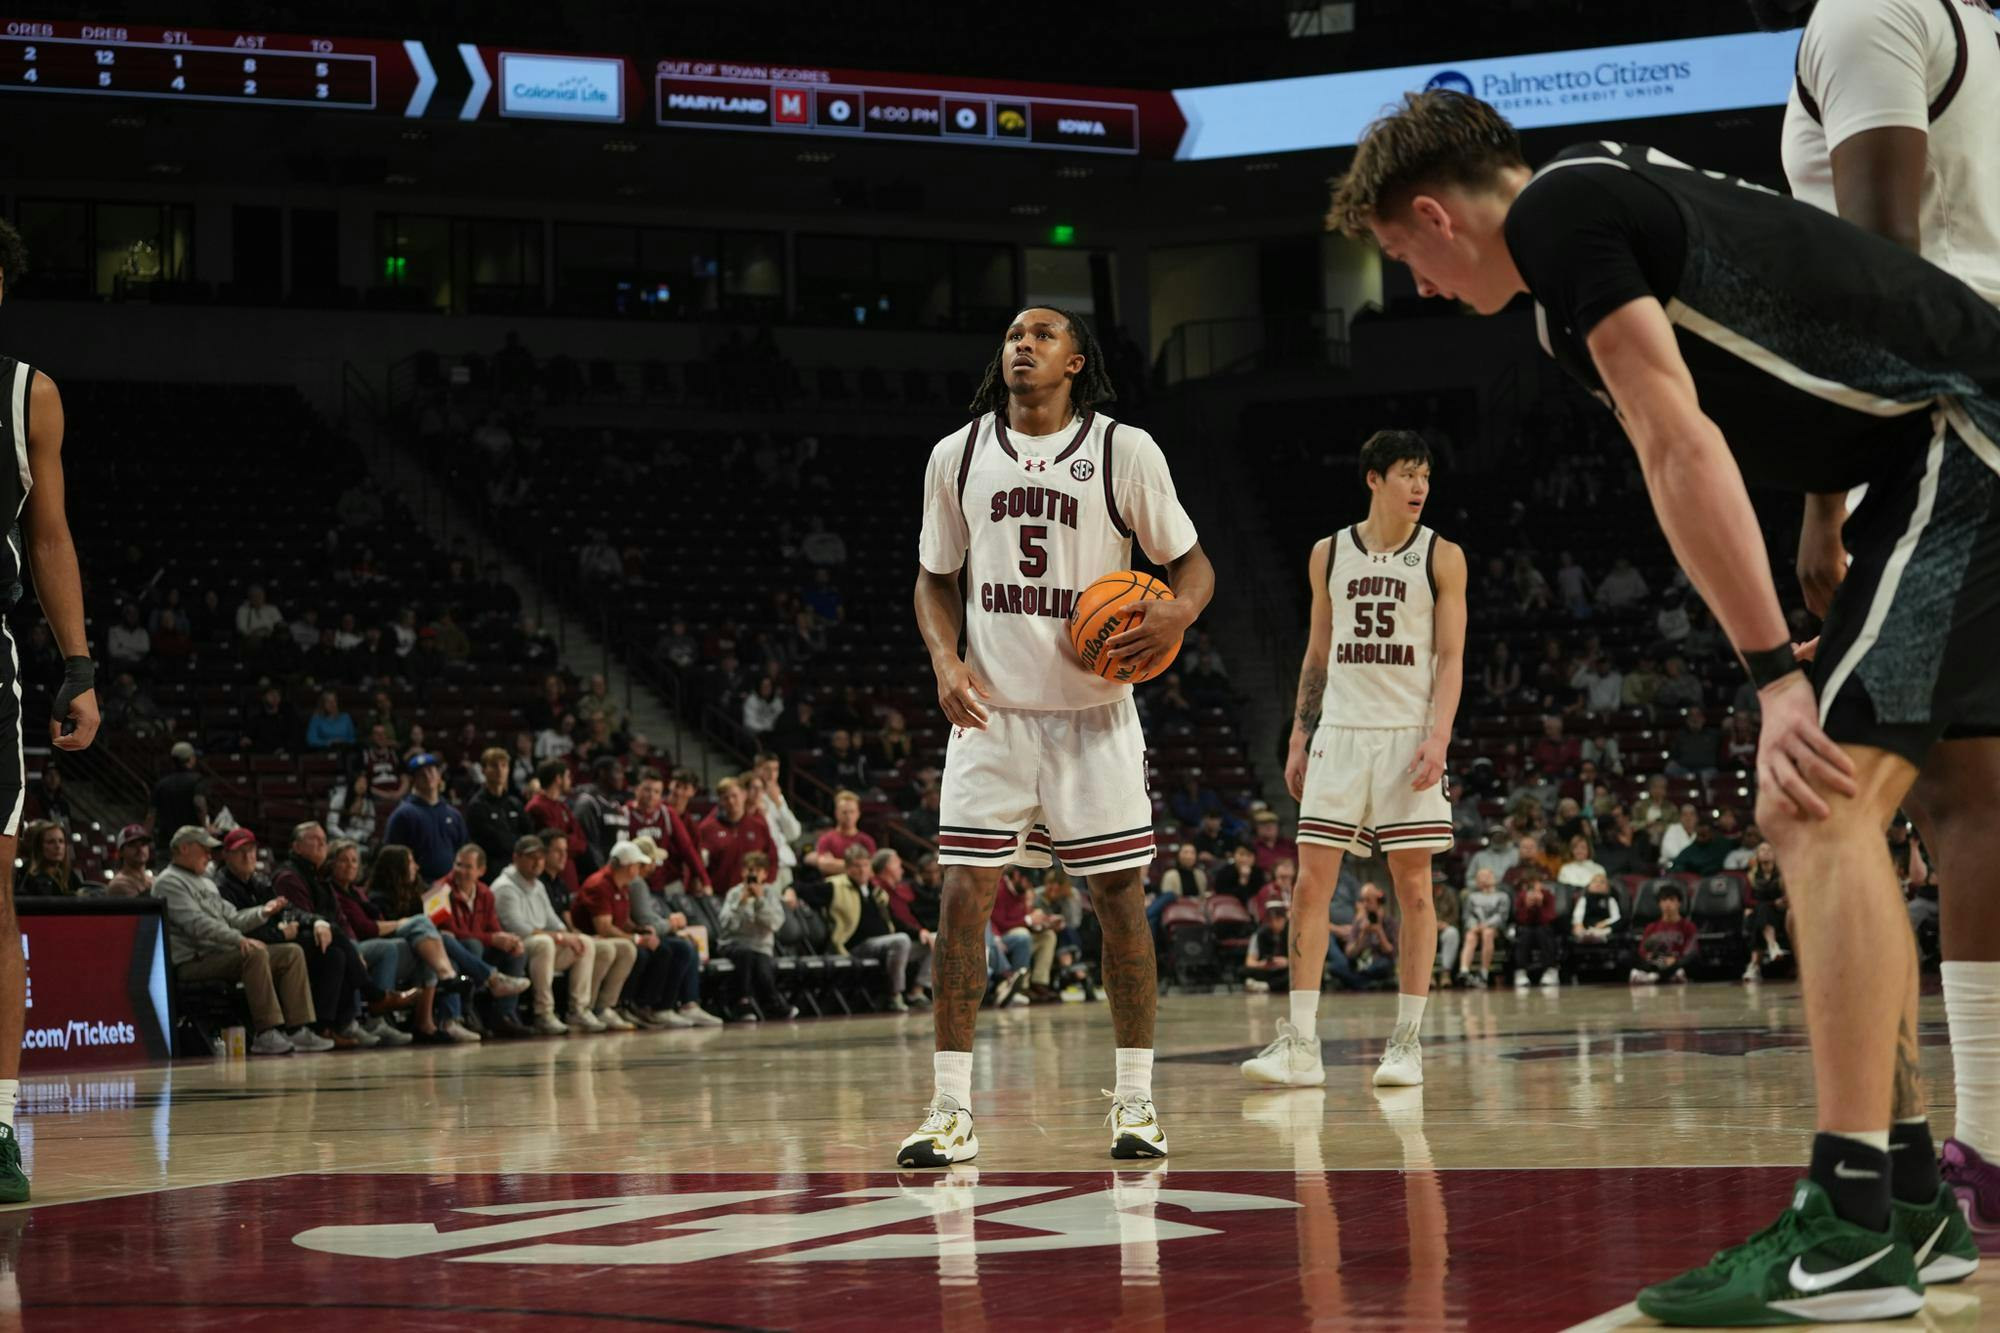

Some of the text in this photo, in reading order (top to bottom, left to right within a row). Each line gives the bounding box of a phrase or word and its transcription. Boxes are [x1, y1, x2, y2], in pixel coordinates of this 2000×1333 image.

[6, 22, 334, 53] OREB DREB STL AST TO
[23, 46, 38, 61] 2
[94, 49, 116, 65] 12
[173, 54, 183, 69] 1
[656, 60, 831, 83] OUT OF TOWN SCORES
[22, 67, 39, 83] 4
[170, 75, 186, 91] 4
[243, 79, 258, 95] 2
[315, 82, 330, 99] 3
[512, 83, 608, 102] Colonial Life
[1481, 60, 1691, 98] Palmetto Citizens
[1493, 84, 1675, 110] EDERAL CREDIT UNION
[667, 93, 768, 114] MARYLAND
[781, 94, 801, 116] M
[867, 105, 910, 123] 4:00
[912, 107, 939, 125] PM
[1057, 118, 1106, 136] IOWA
[1071, 460, 1094, 480] SEC
[991, 486, 1079, 530] SOUTH
[1019, 524, 1048, 578] 5
[1346, 576, 1407, 602] SOUTH
[1354, 602, 1396, 638] 55
[1337, 643, 1416, 666] CAROLINA
[21, 1019, 135, 1050] .com/Tickets
